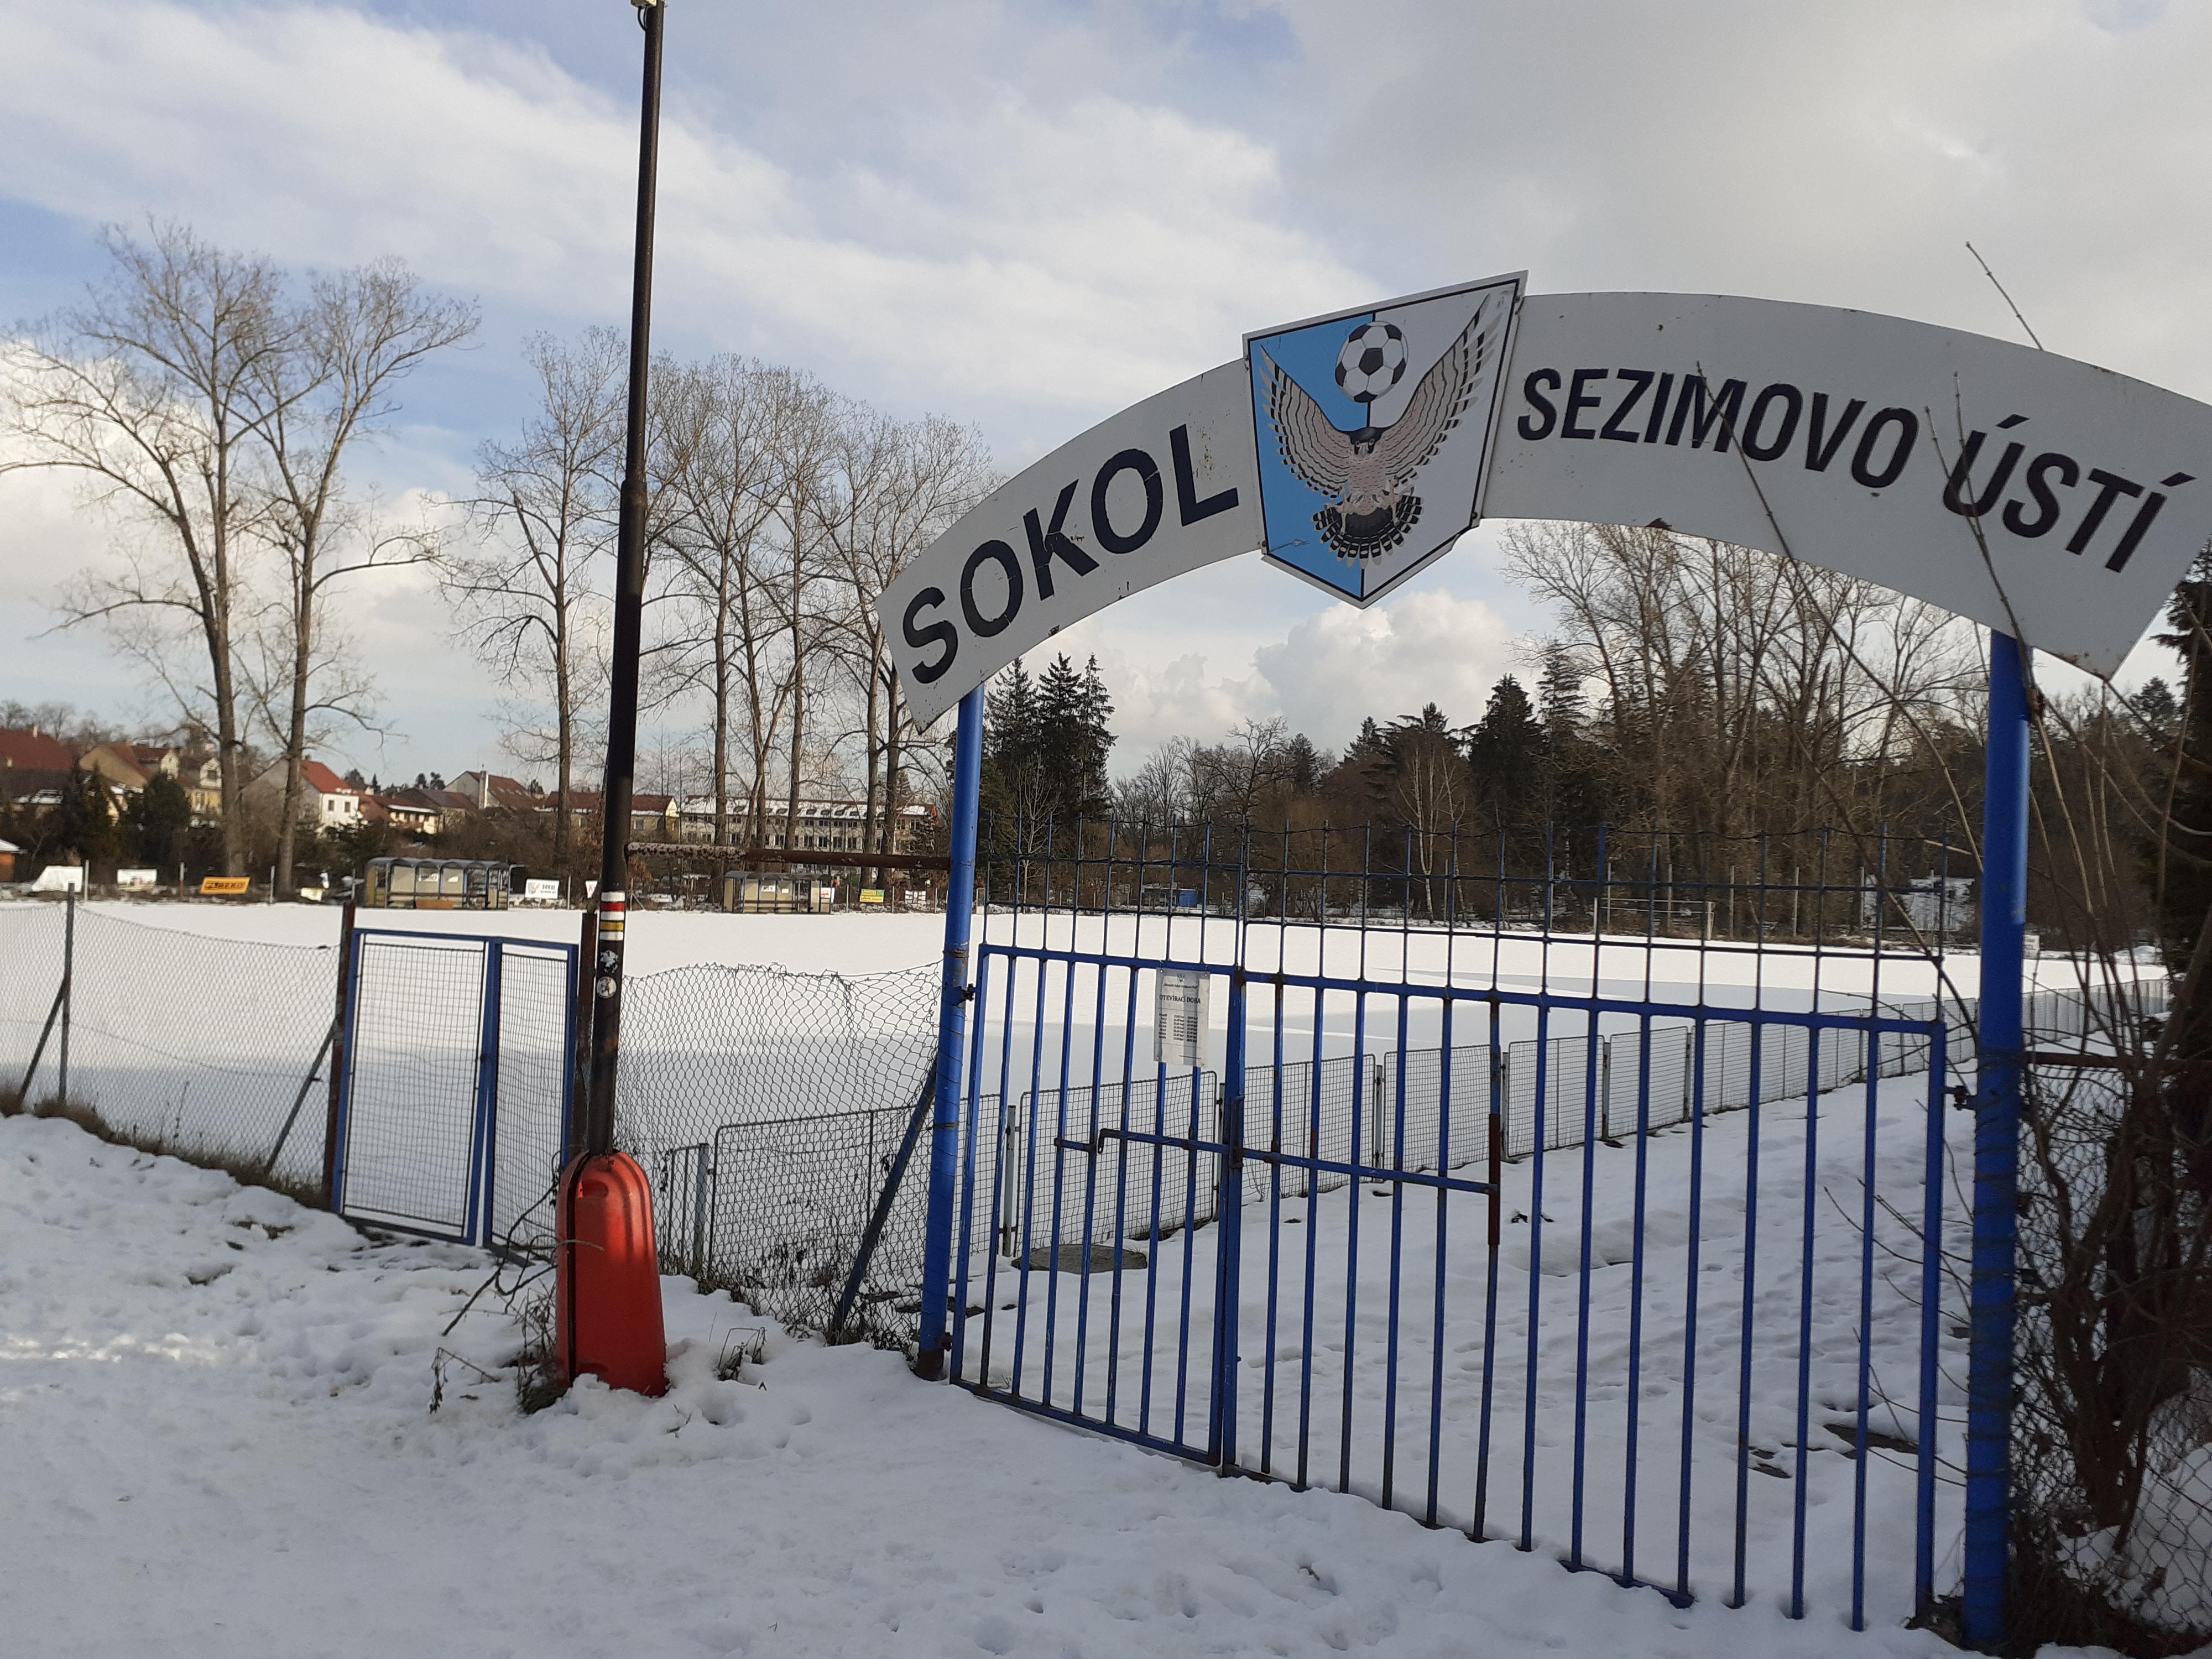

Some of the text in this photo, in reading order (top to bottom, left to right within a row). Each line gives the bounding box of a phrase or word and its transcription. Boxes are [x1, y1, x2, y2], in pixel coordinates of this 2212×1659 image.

[902, 424, 1239, 684] SOKOL
[1517, 368, 2197, 573] SEZIMOVO ÚSTÍ
